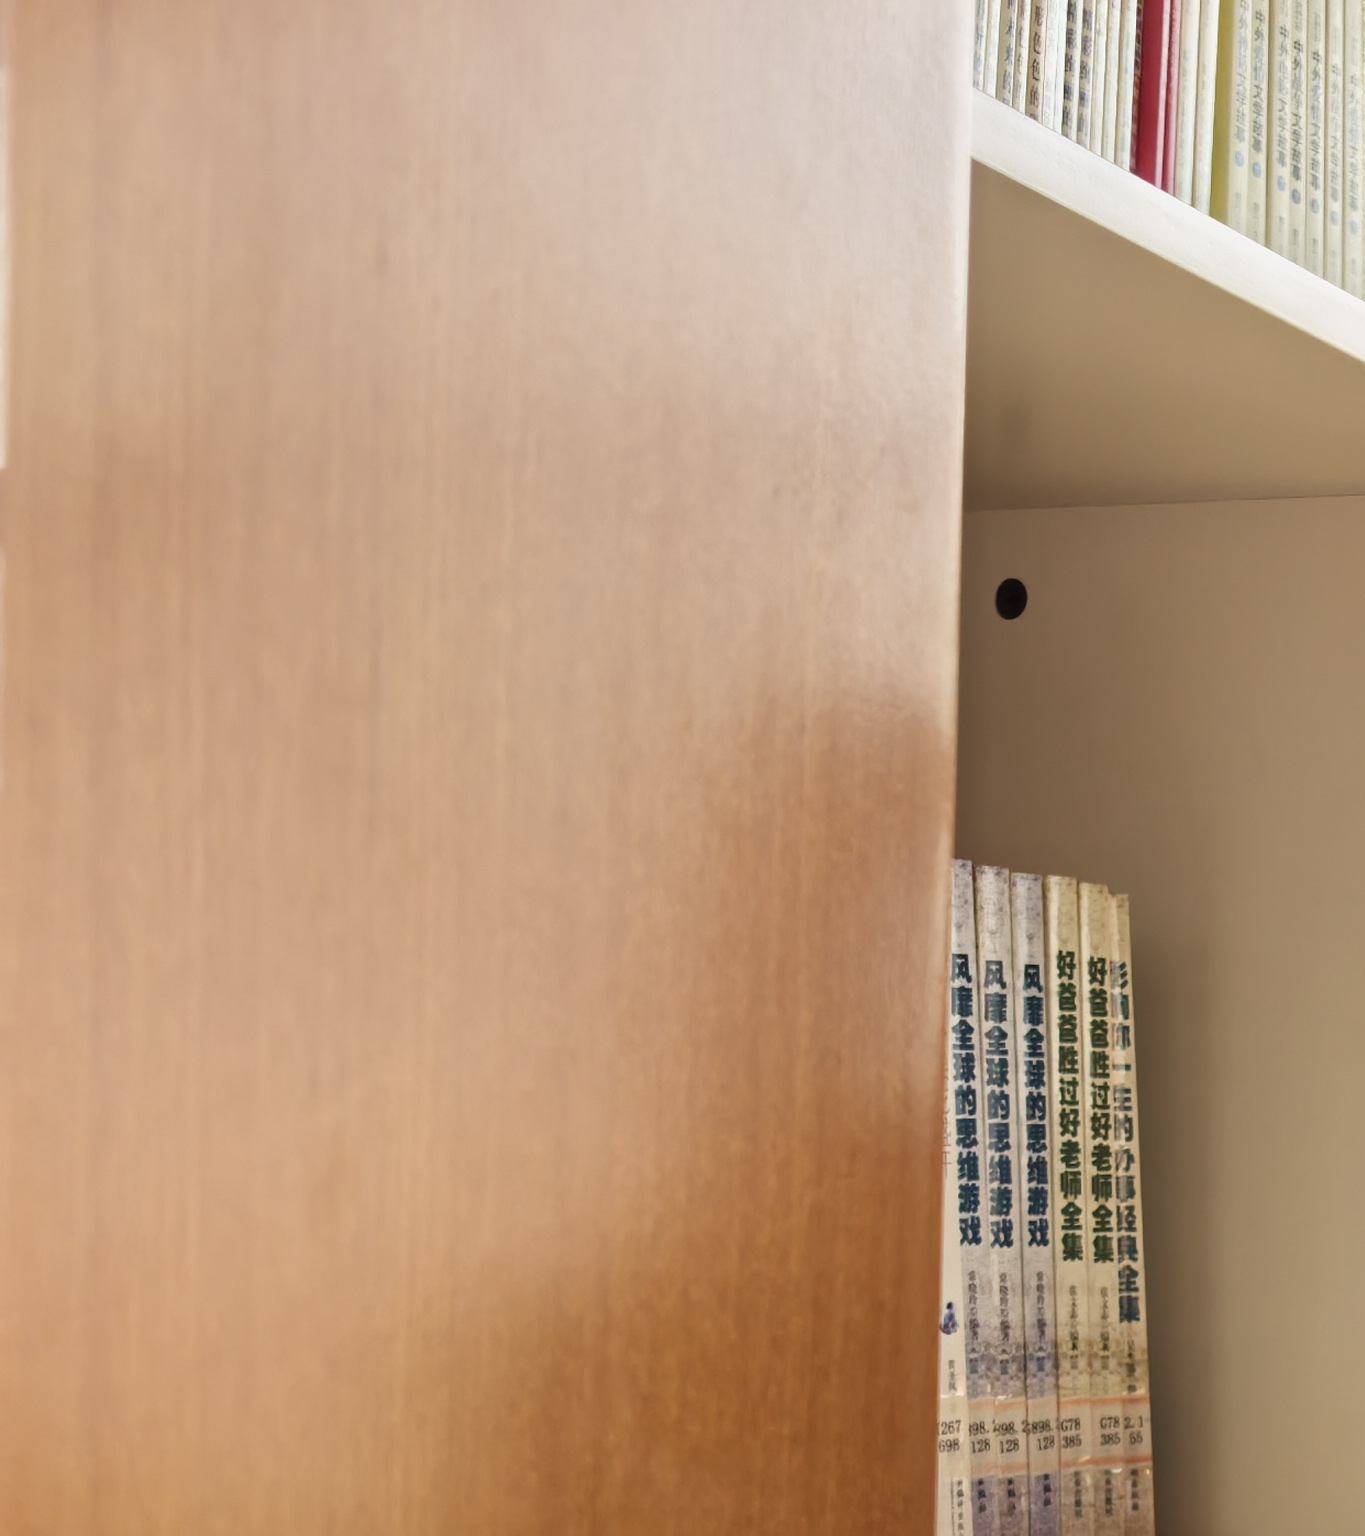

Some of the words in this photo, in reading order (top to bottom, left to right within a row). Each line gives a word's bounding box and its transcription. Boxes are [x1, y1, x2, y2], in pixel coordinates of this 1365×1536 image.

[952, 953, 982, 1246] 风靡全球的思维游戏
[984, 960, 1013, 1249] 风靡全球的思维游戏
[1022, 964, 1049, 1249] 风靡全球的思维游戏
[1056, 950, 1083, 1263] 好爸爸胜过好老师全集
[1087, 956, 1114, 1263] 好爸爸胜过好老师全集
[937, 1419, 961, 1435] 267
